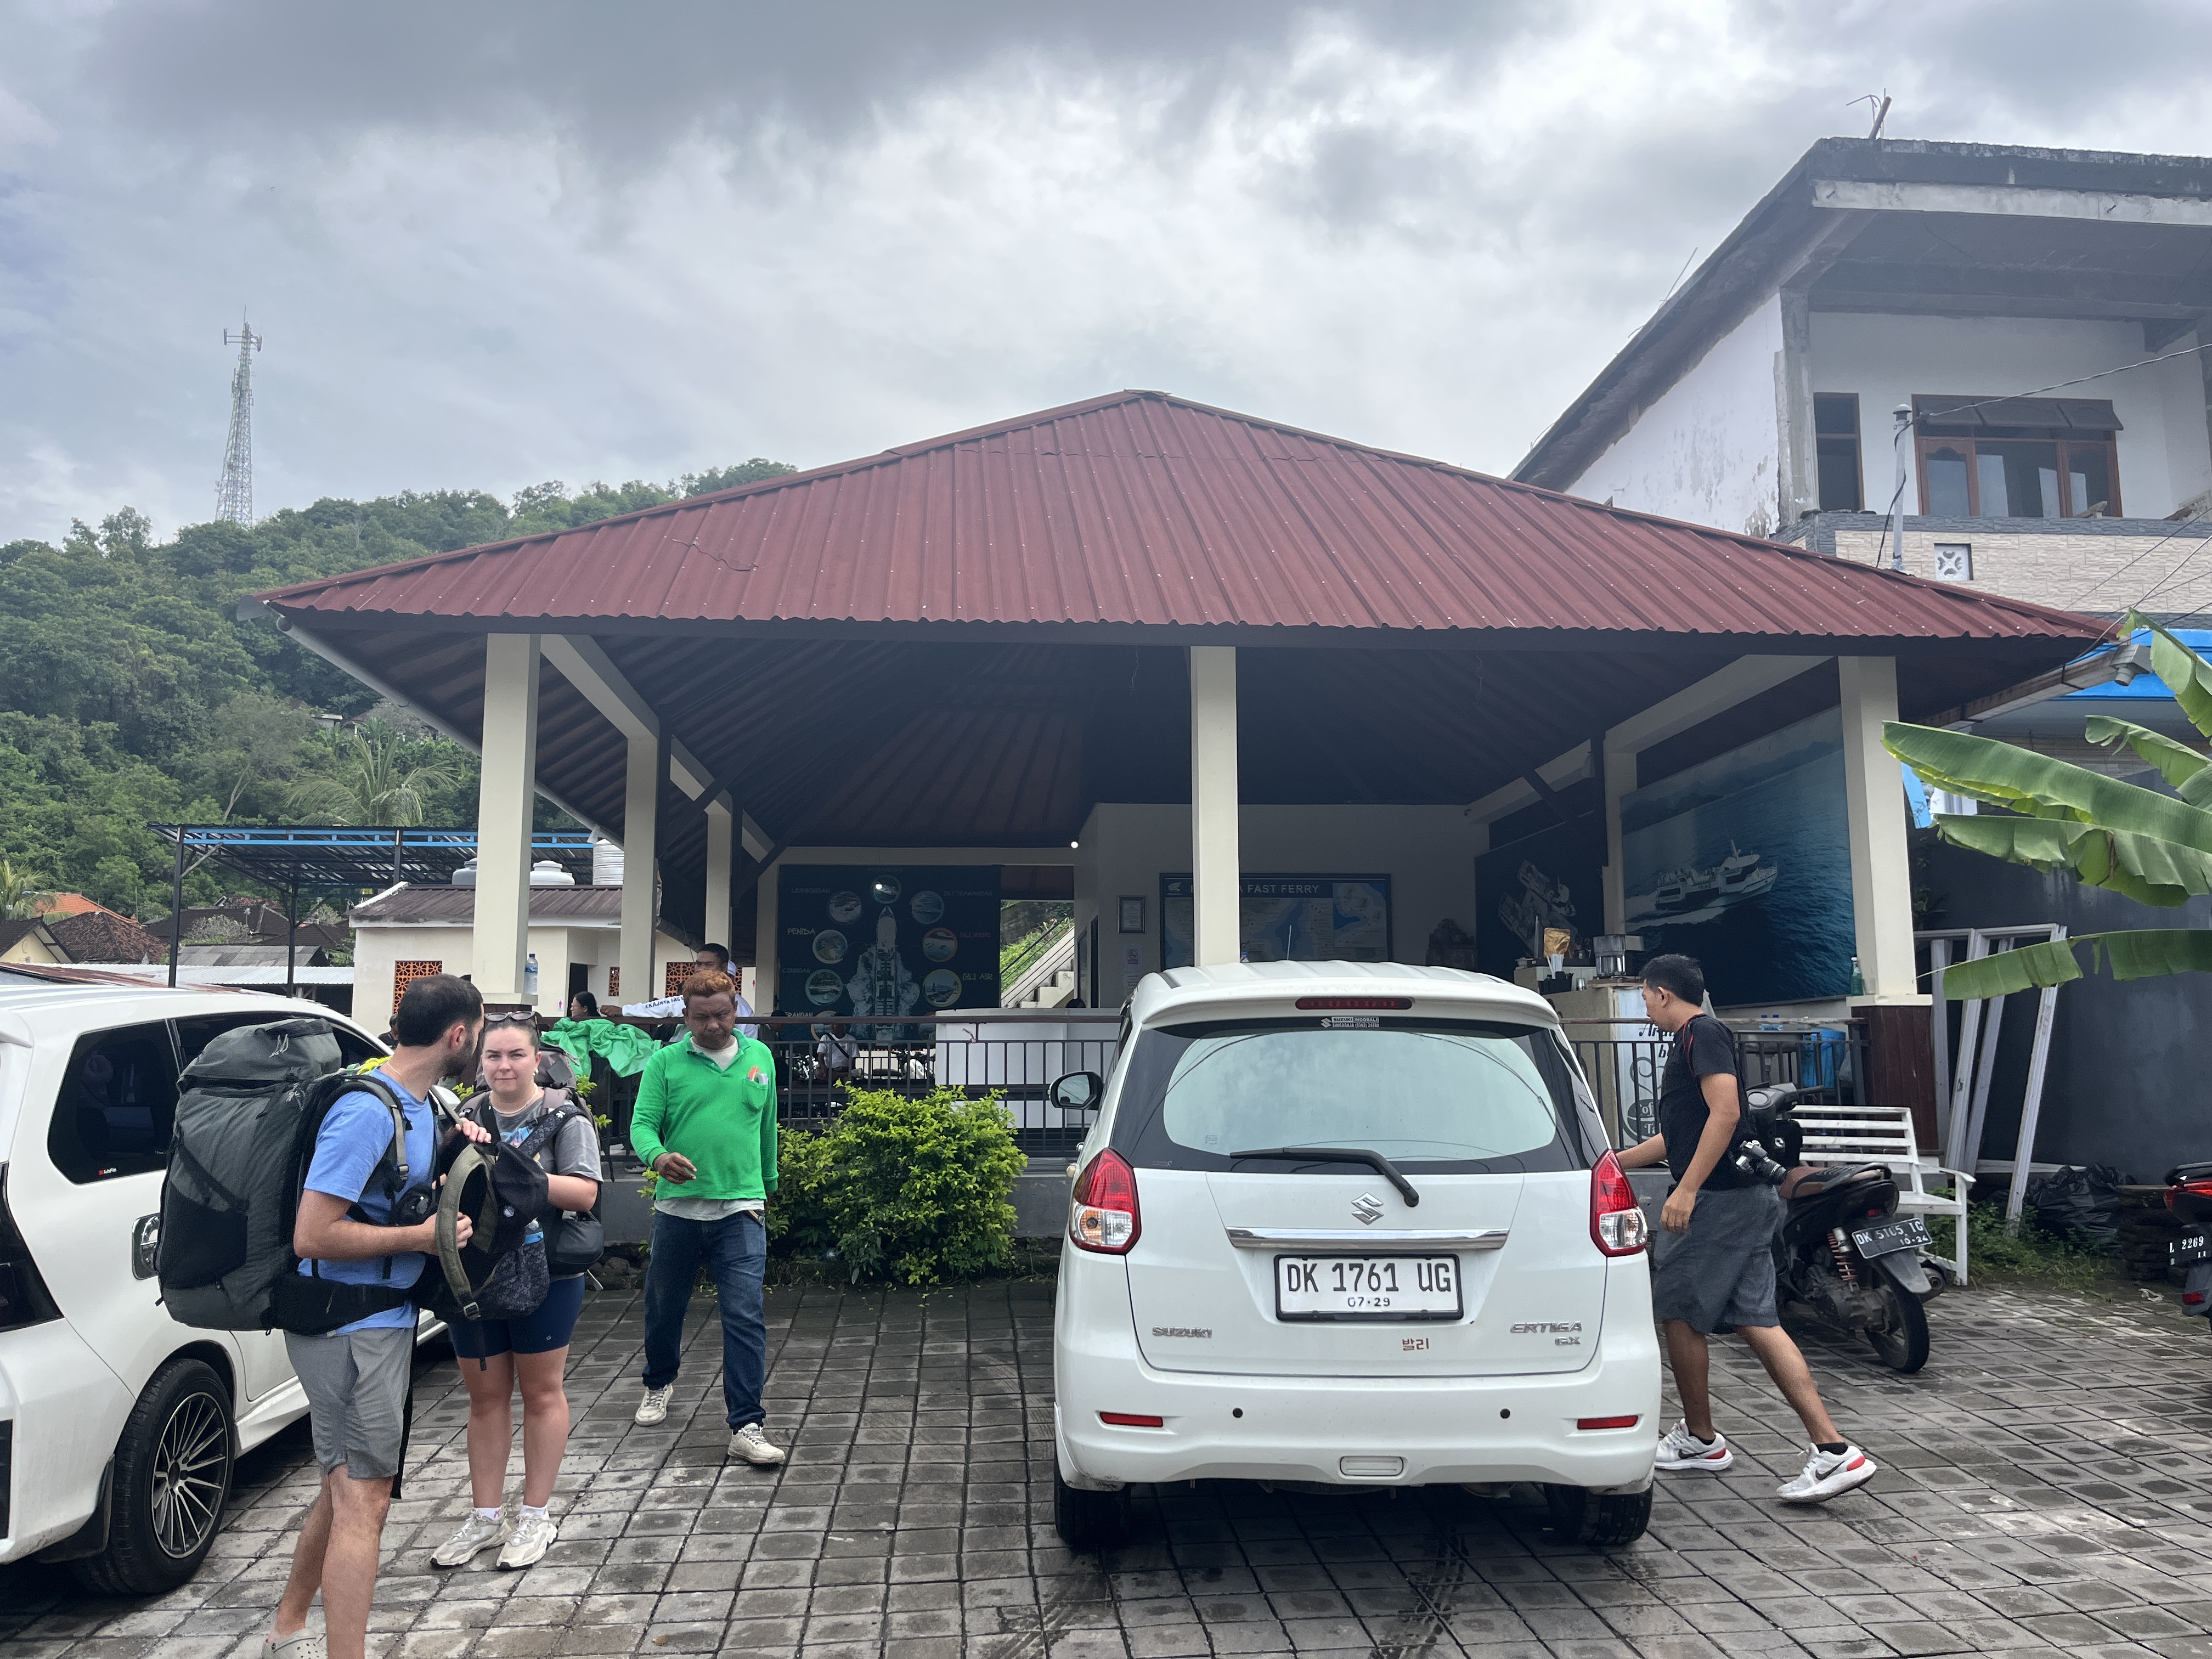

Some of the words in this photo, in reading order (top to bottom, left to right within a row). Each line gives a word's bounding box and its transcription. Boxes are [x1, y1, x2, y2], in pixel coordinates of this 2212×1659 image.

[1247, 884, 1277, 894] FAST
[1281, 884, 1319, 894] FERRY
[645, 1000, 670, 1008] EKAJAYA
[1855, 1232, 1872, 1245] DK
[2181, 1236, 2204, 1250] 2269
[1286, 1263, 1319, 1293] DK
[1331, 1263, 1399, 1292] 1761
[1417, 1263, 1452, 1293] UG
[1152, 1325, 1212, 1338] SUZUKI
[1510, 1321, 1583, 1333] ERTIGA
[1402, 1338, 1429, 1351] 발리
[1554, 1336, 1581, 1346] GX
